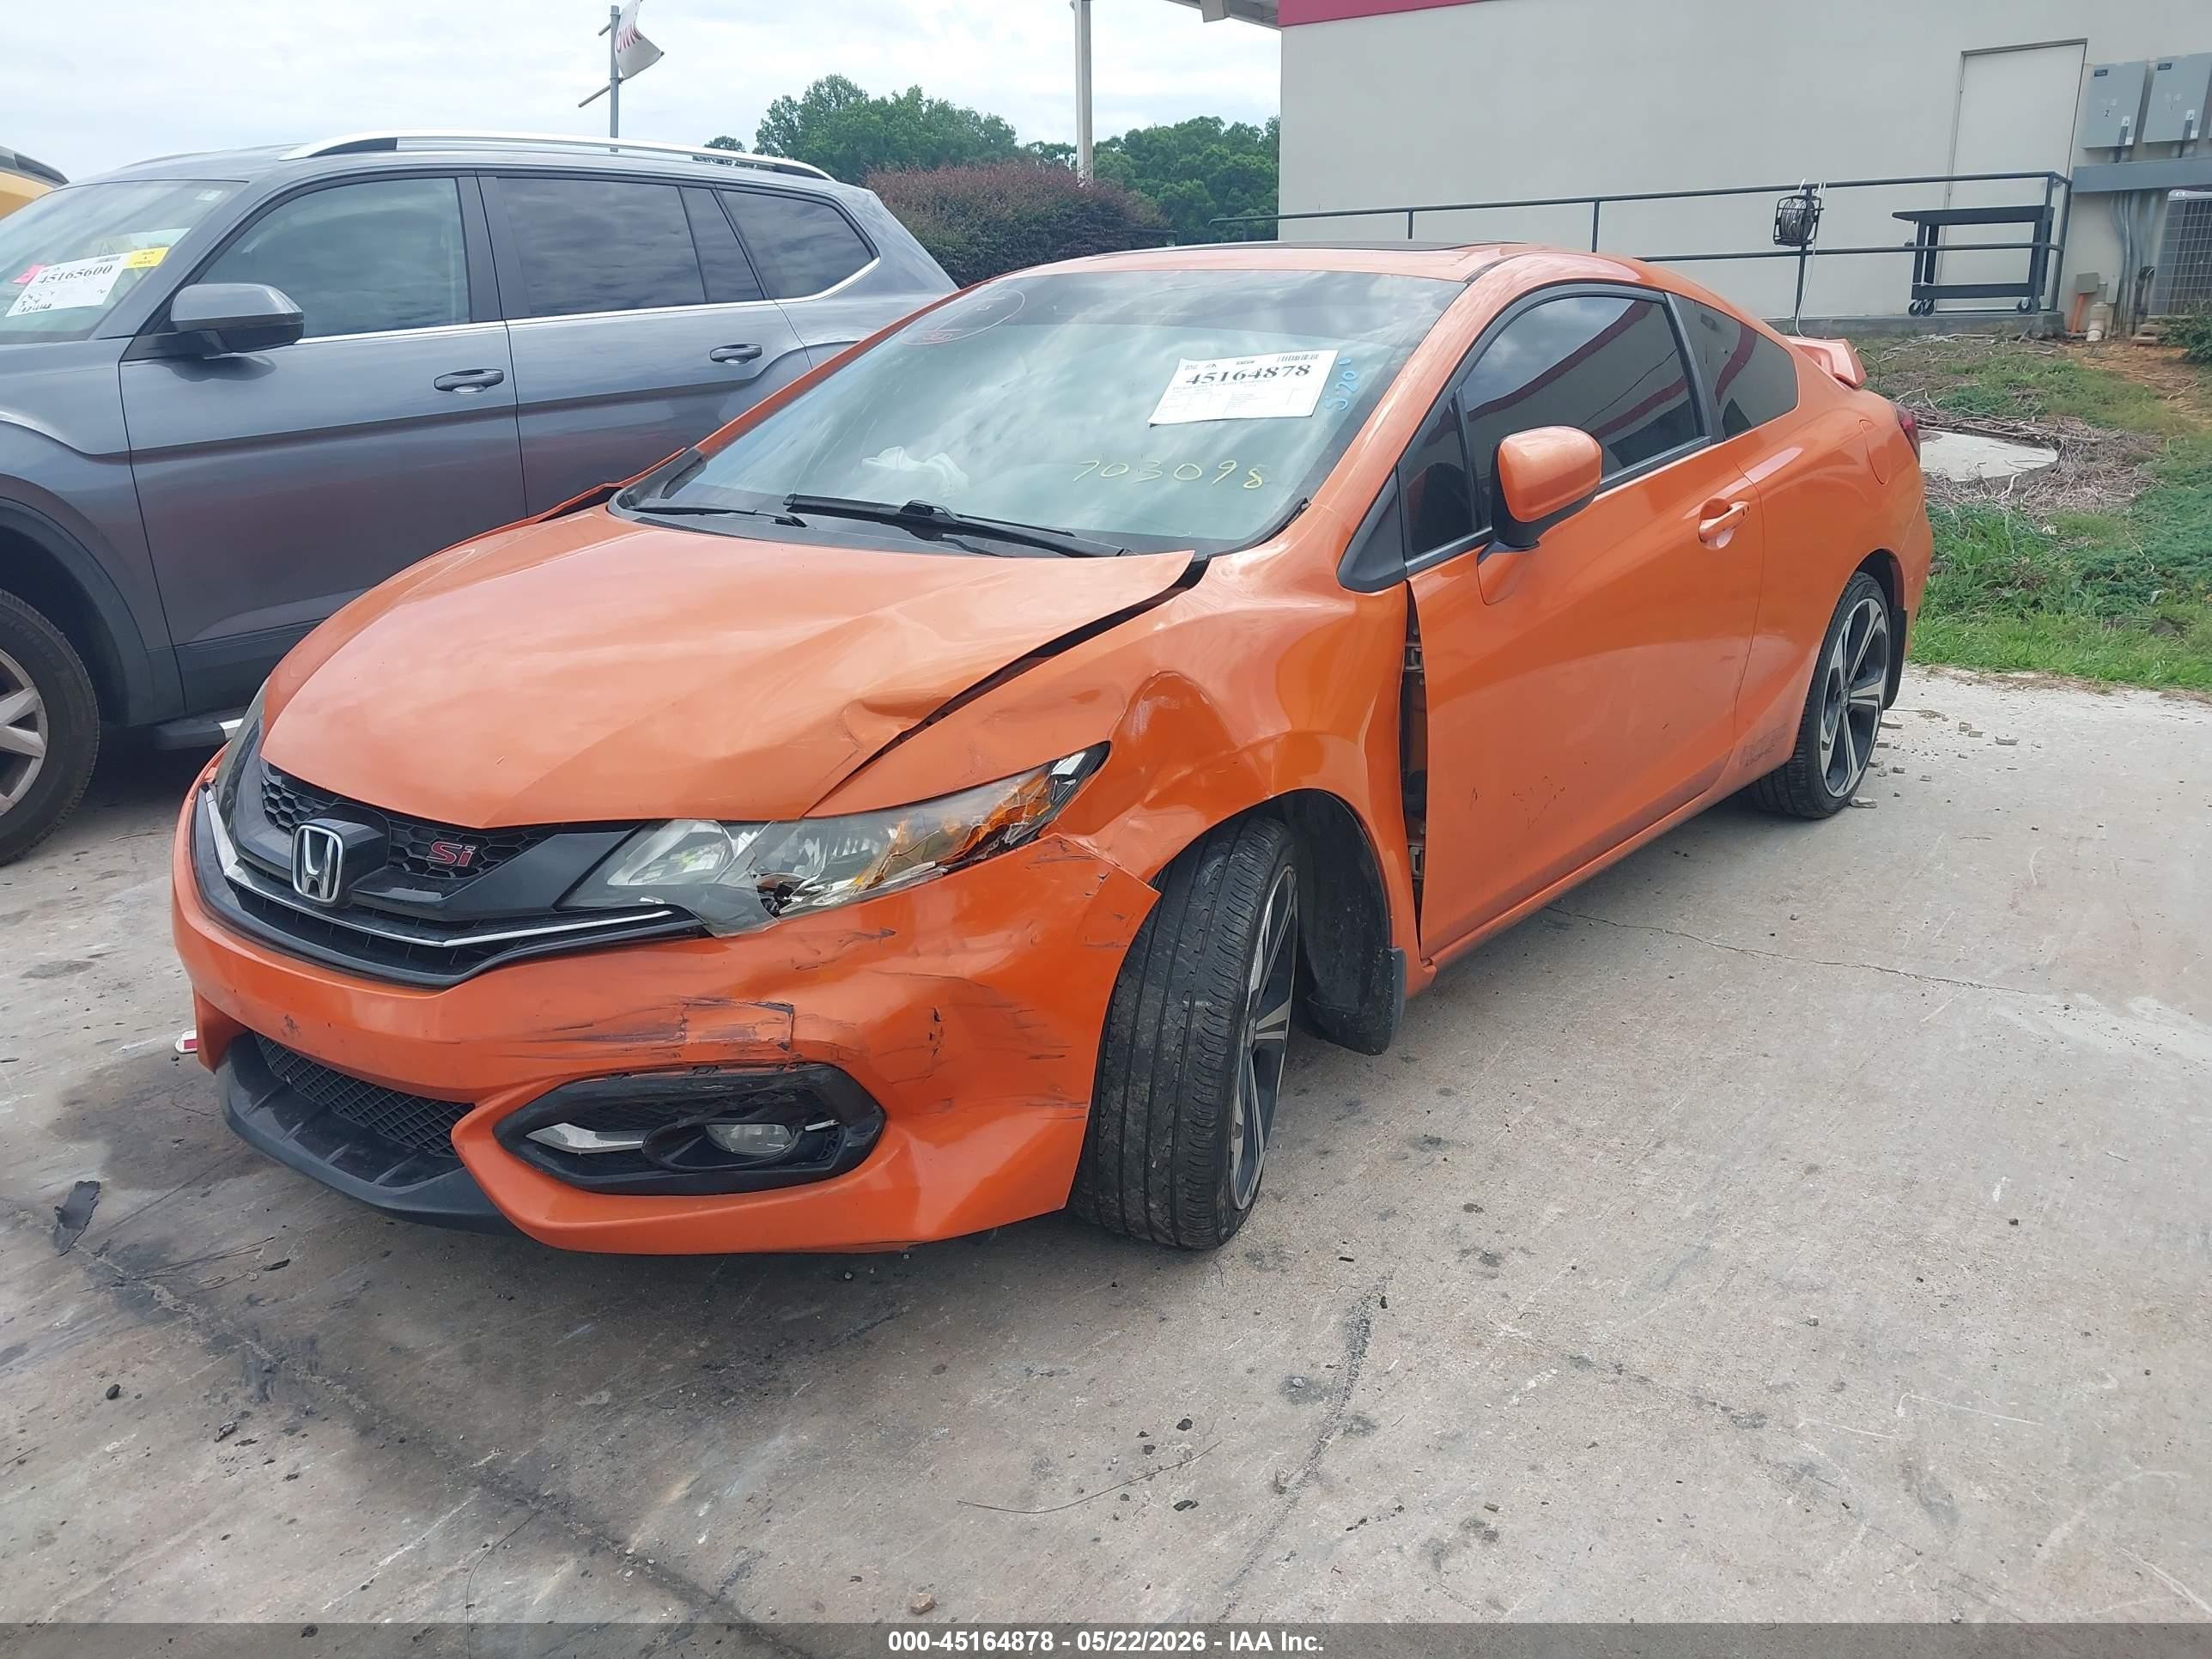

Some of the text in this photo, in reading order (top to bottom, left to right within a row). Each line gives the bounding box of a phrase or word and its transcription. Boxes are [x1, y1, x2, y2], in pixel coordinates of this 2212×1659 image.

[37, 264, 113, 284] 45165600
[1185, 364, 1312, 386] 45164878
[1073, 459, 1266, 489] 703098
[427, 841, 477, 867] Si
